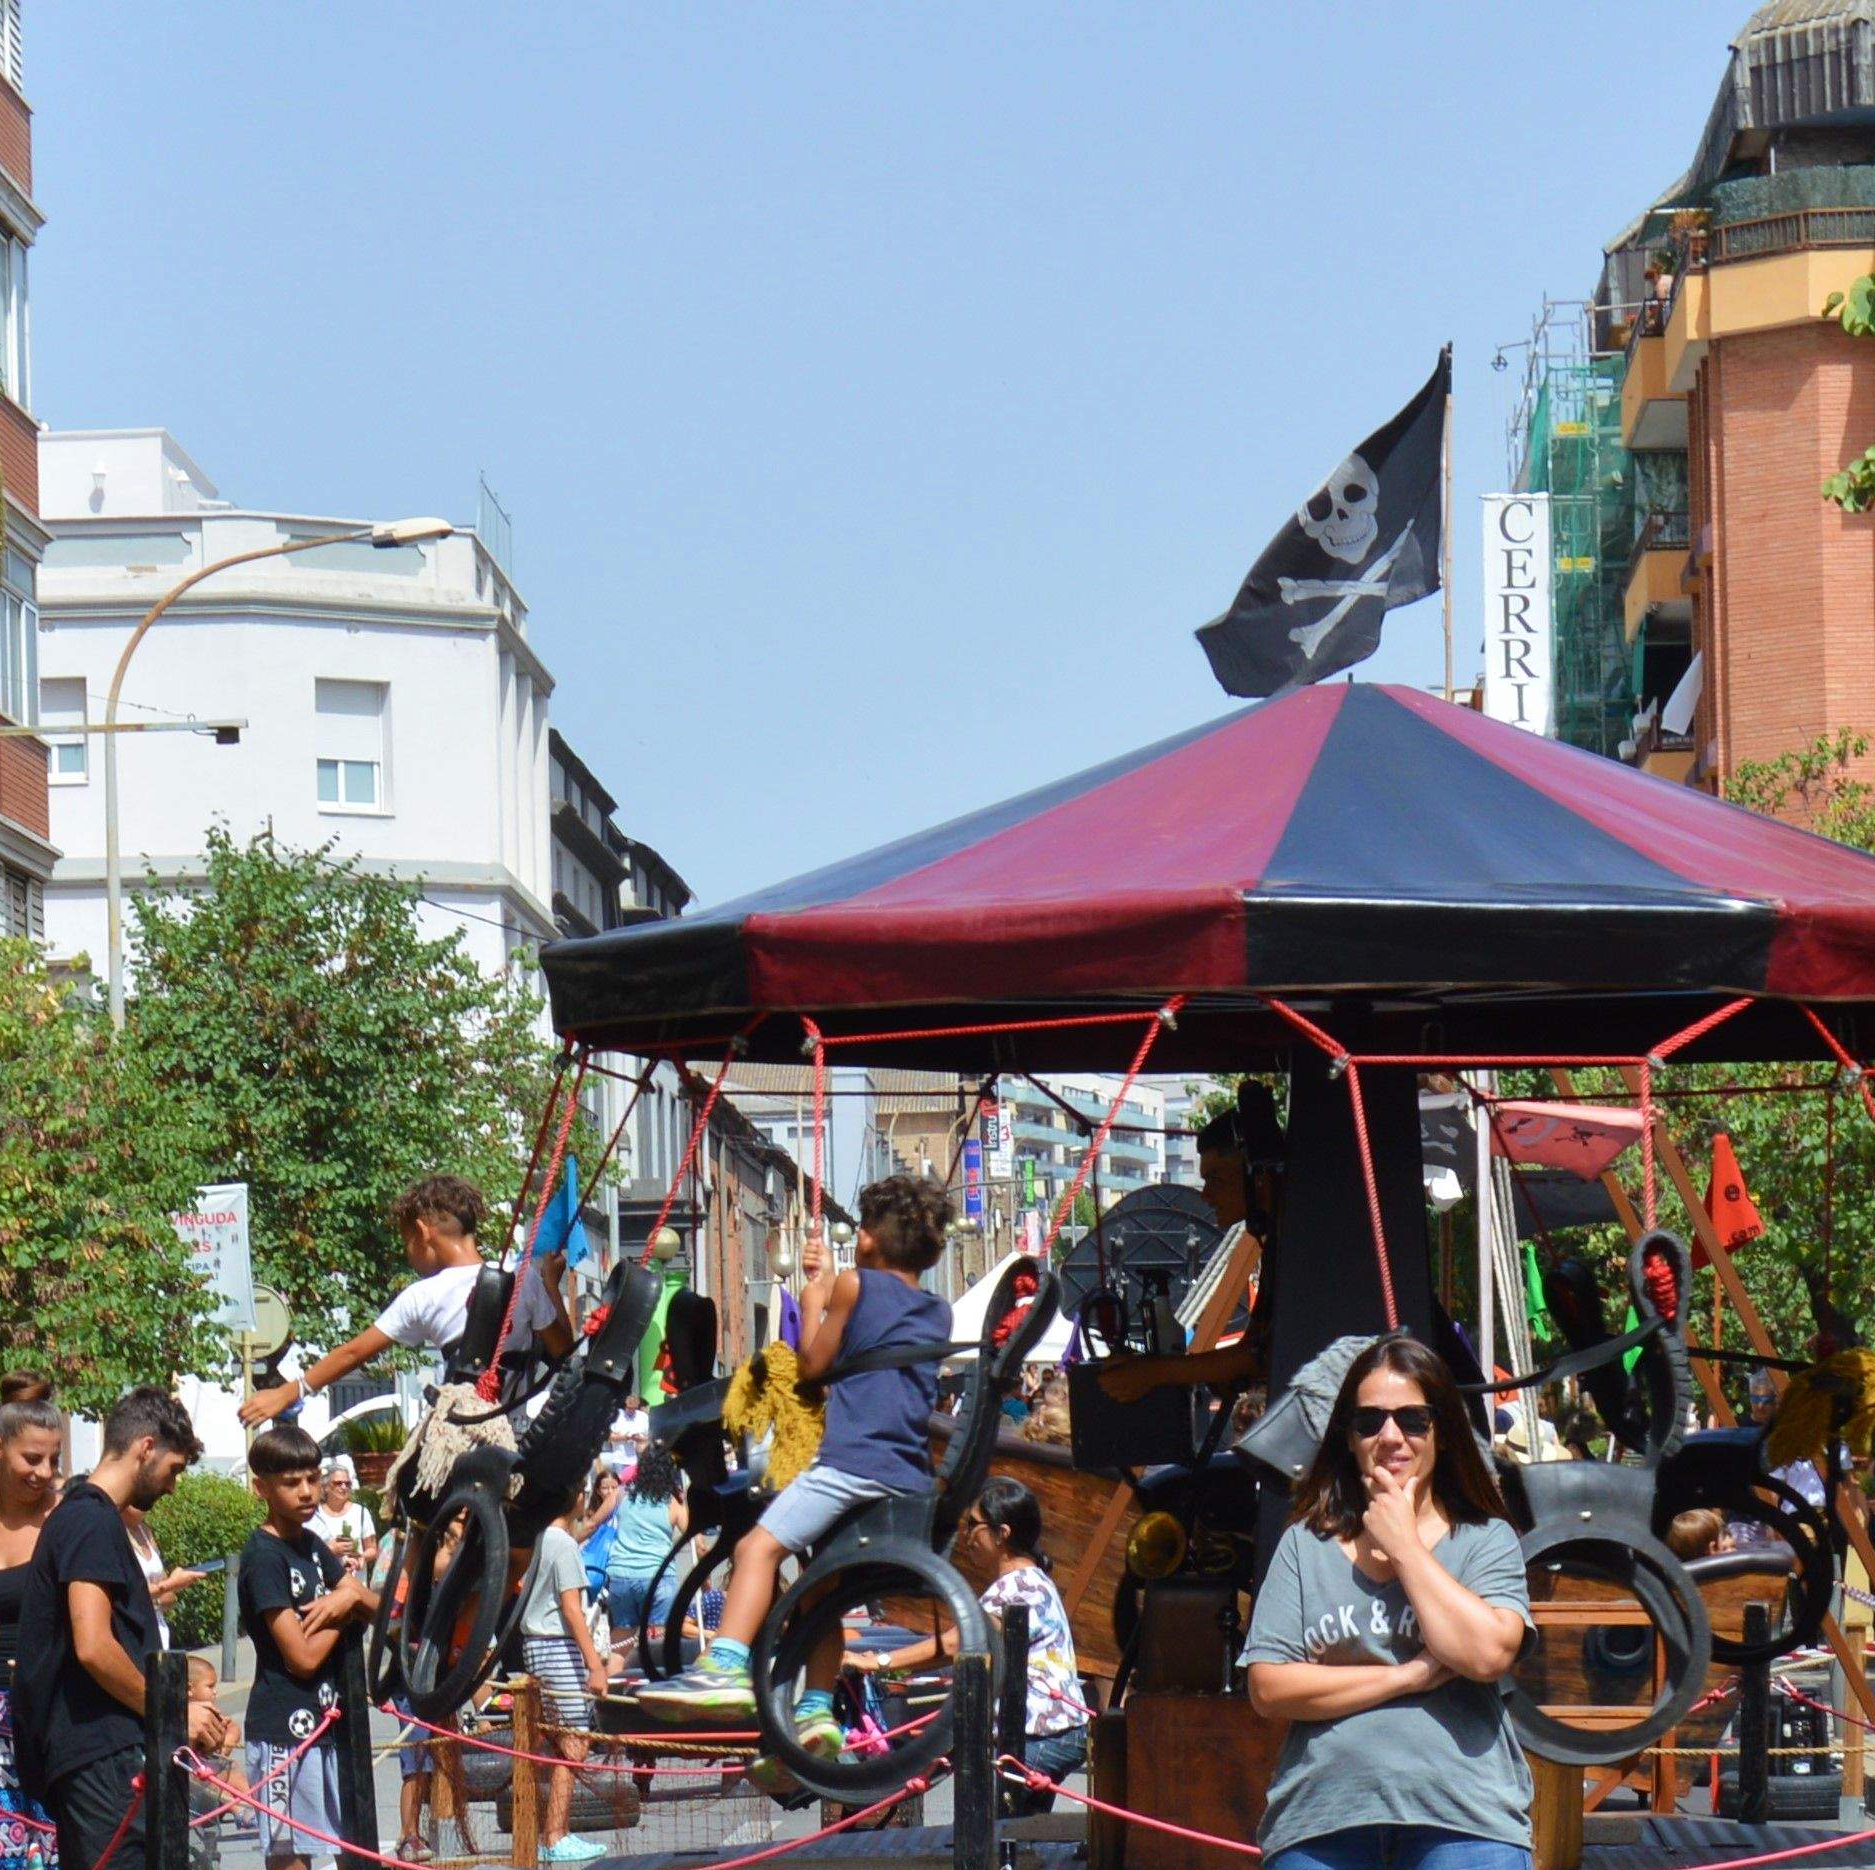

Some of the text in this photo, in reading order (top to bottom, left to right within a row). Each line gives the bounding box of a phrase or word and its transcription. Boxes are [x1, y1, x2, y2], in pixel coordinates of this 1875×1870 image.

[1498, 501, 1540, 732] CERRI
[171, 1211, 237, 1226] VINGUDA
[1304, 1604, 1360, 1655] OCK
[1370, 1600, 1389, 1635] &
